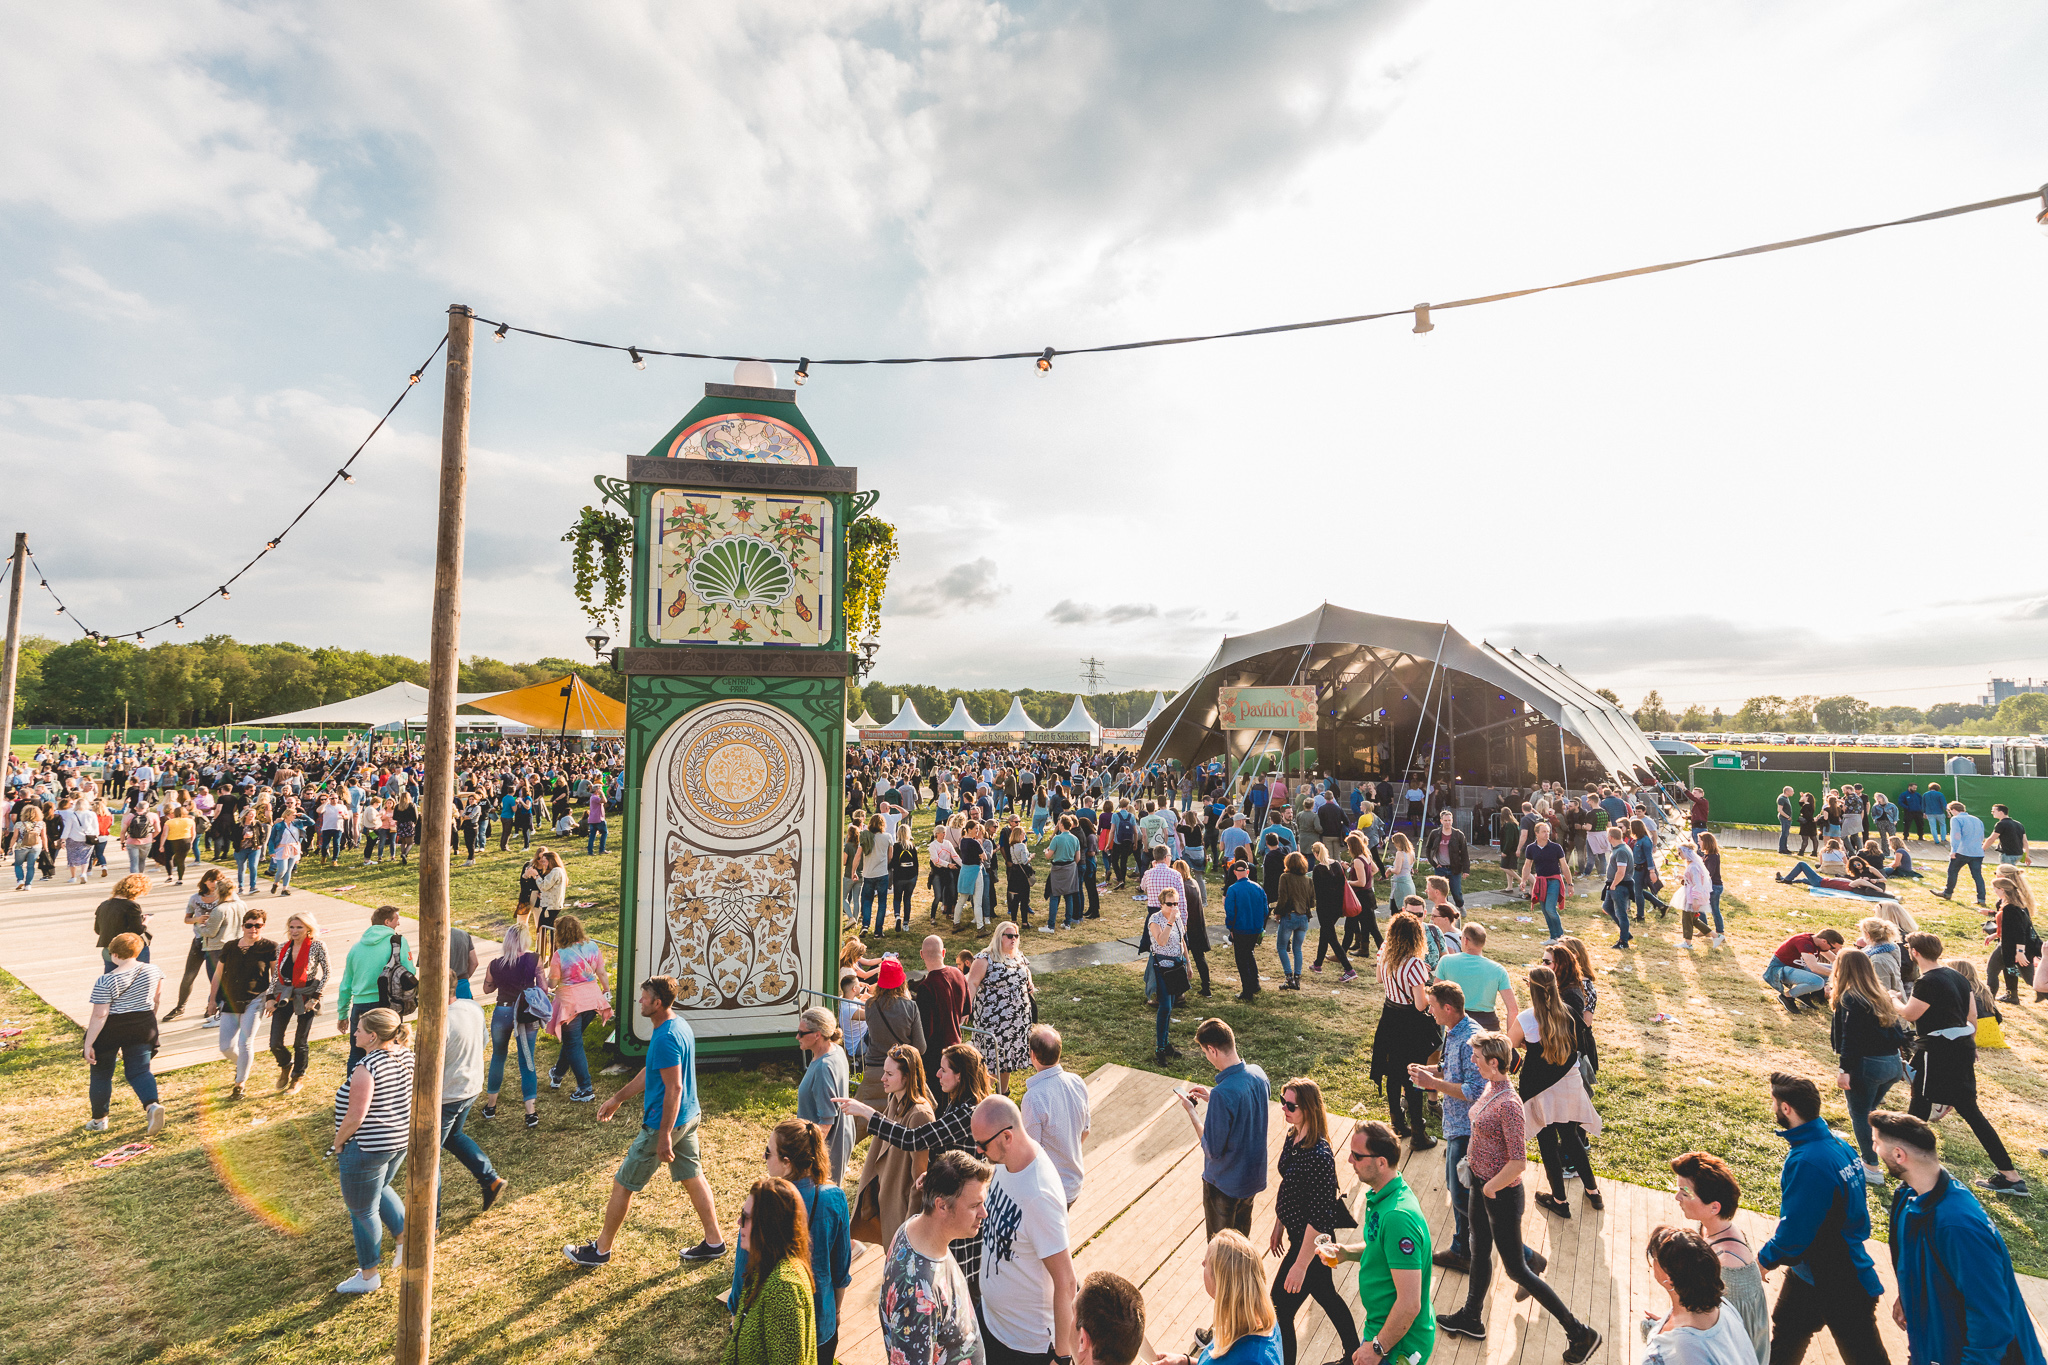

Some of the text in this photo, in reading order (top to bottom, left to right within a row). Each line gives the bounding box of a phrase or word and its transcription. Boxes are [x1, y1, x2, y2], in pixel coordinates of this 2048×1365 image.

[722, 677, 756, 686] CENTRAL
[729, 685, 749, 693] PARK
[864, 730, 903, 739] Flammkuchen
[994, 732, 1015, 741] Snacks
[1035, 732, 1050, 741] Friet
[1056, 732, 1079, 741] Snacks
